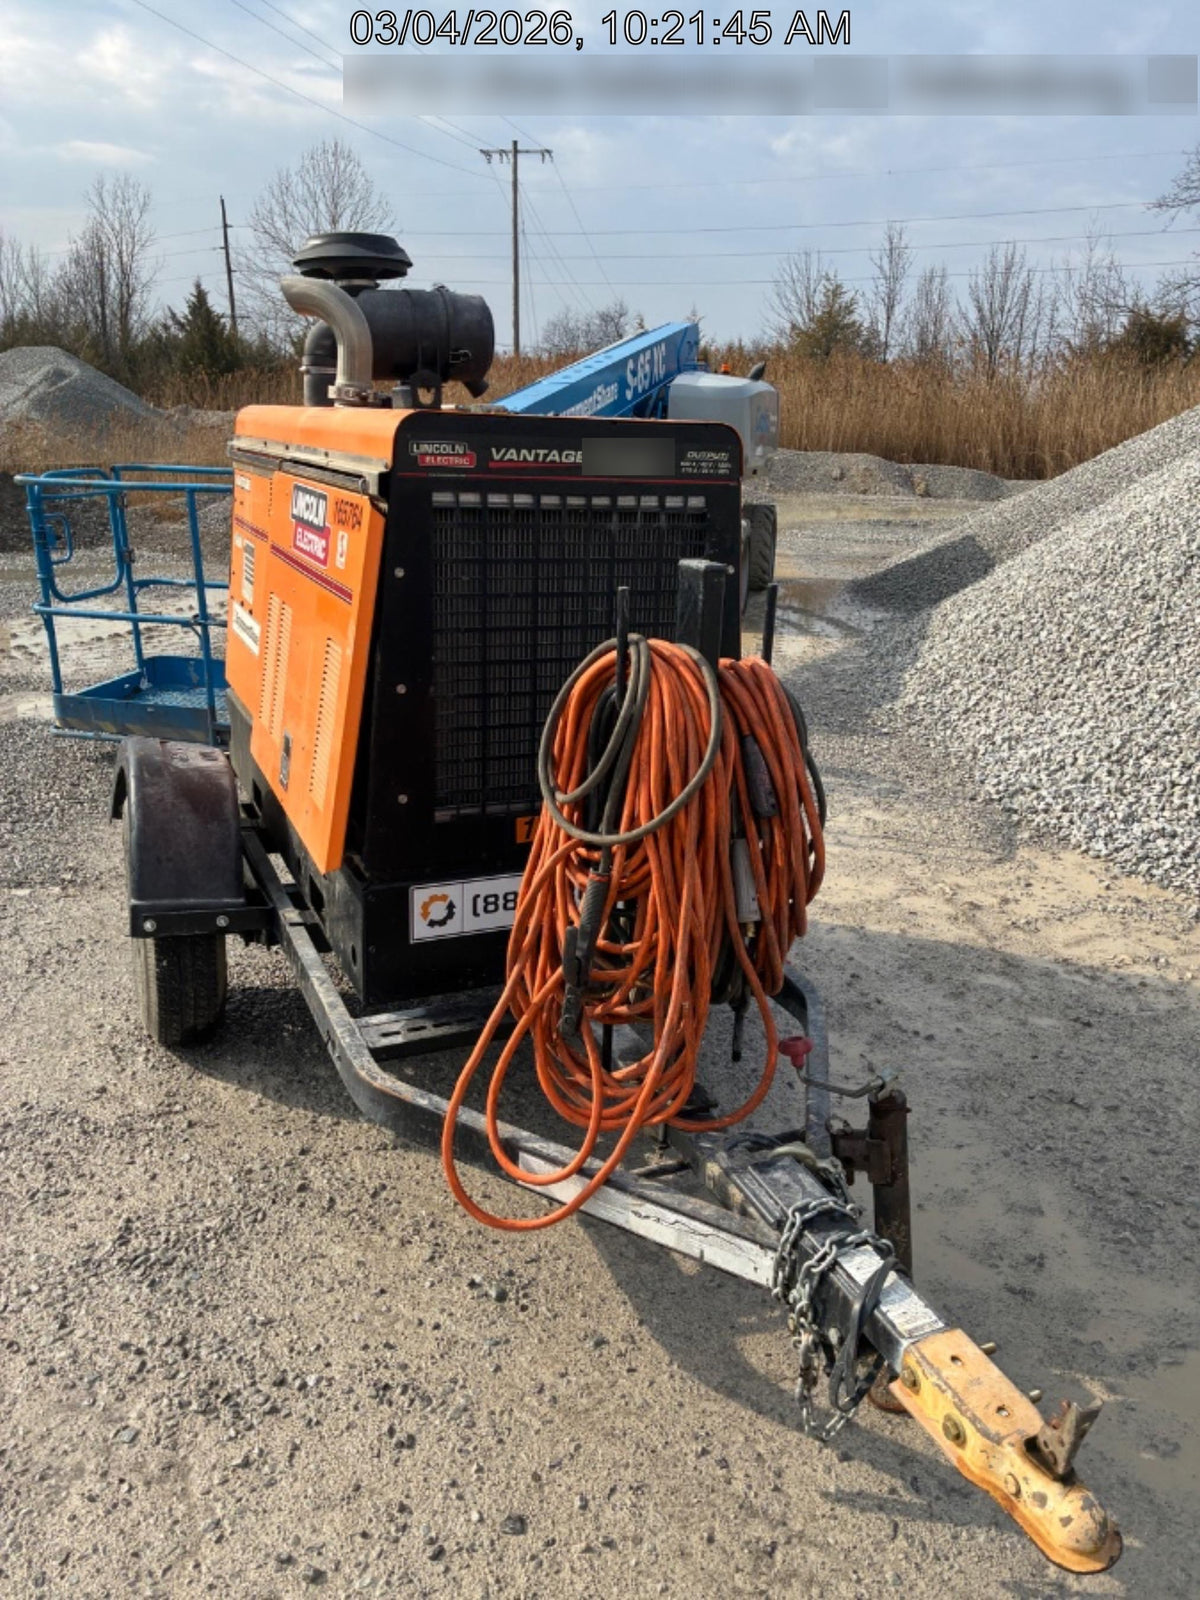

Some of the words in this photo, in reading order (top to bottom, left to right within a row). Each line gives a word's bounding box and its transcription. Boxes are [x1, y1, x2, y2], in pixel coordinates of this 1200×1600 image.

[625, 350, 652, 401] S-65
[412, 442, 464, 454] LINCOLN
[424, 455, 470, 465] ELECTRIC
[292, 488, 326, 527] LINCOLN
[295, 528, 327, 561] ELECTRIC
